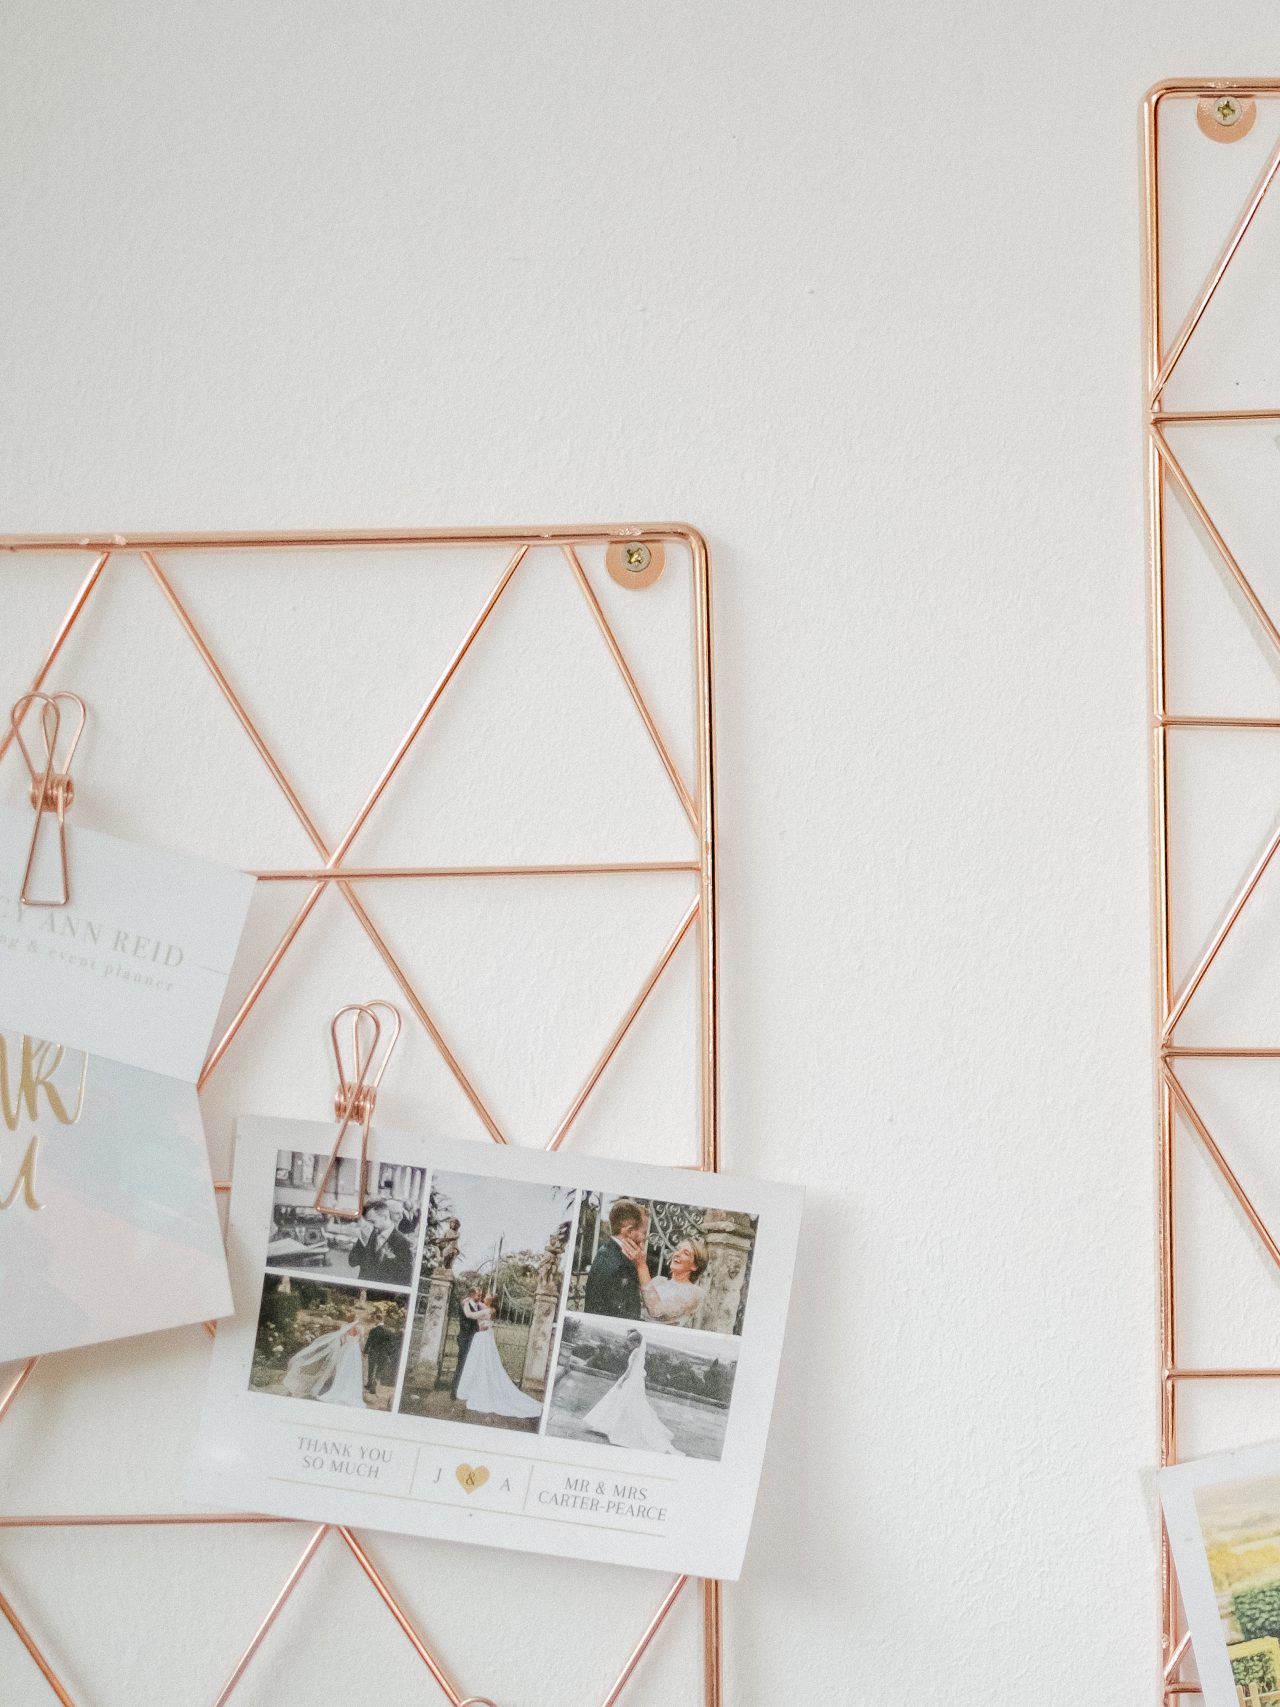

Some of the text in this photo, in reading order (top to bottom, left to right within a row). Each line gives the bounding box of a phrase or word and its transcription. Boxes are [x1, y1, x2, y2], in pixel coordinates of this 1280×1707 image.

[38, 909, 103, 946] ANN
[112, 929, 185, 968] REID
[48, 949, 96, 971] event
[103, 962, 174, 992] planner
[297, 1436, 394, 1464] THANK YOU
[302, 1455, 380, 1480] SO MUCH
[432, 1467, 442, 1484] J
[499, 1477, 512, 1493] A
[564, 1477, 648, 1502] MR & MRS
[538, 1490, 668, 1523] CARTER-PEARCE
